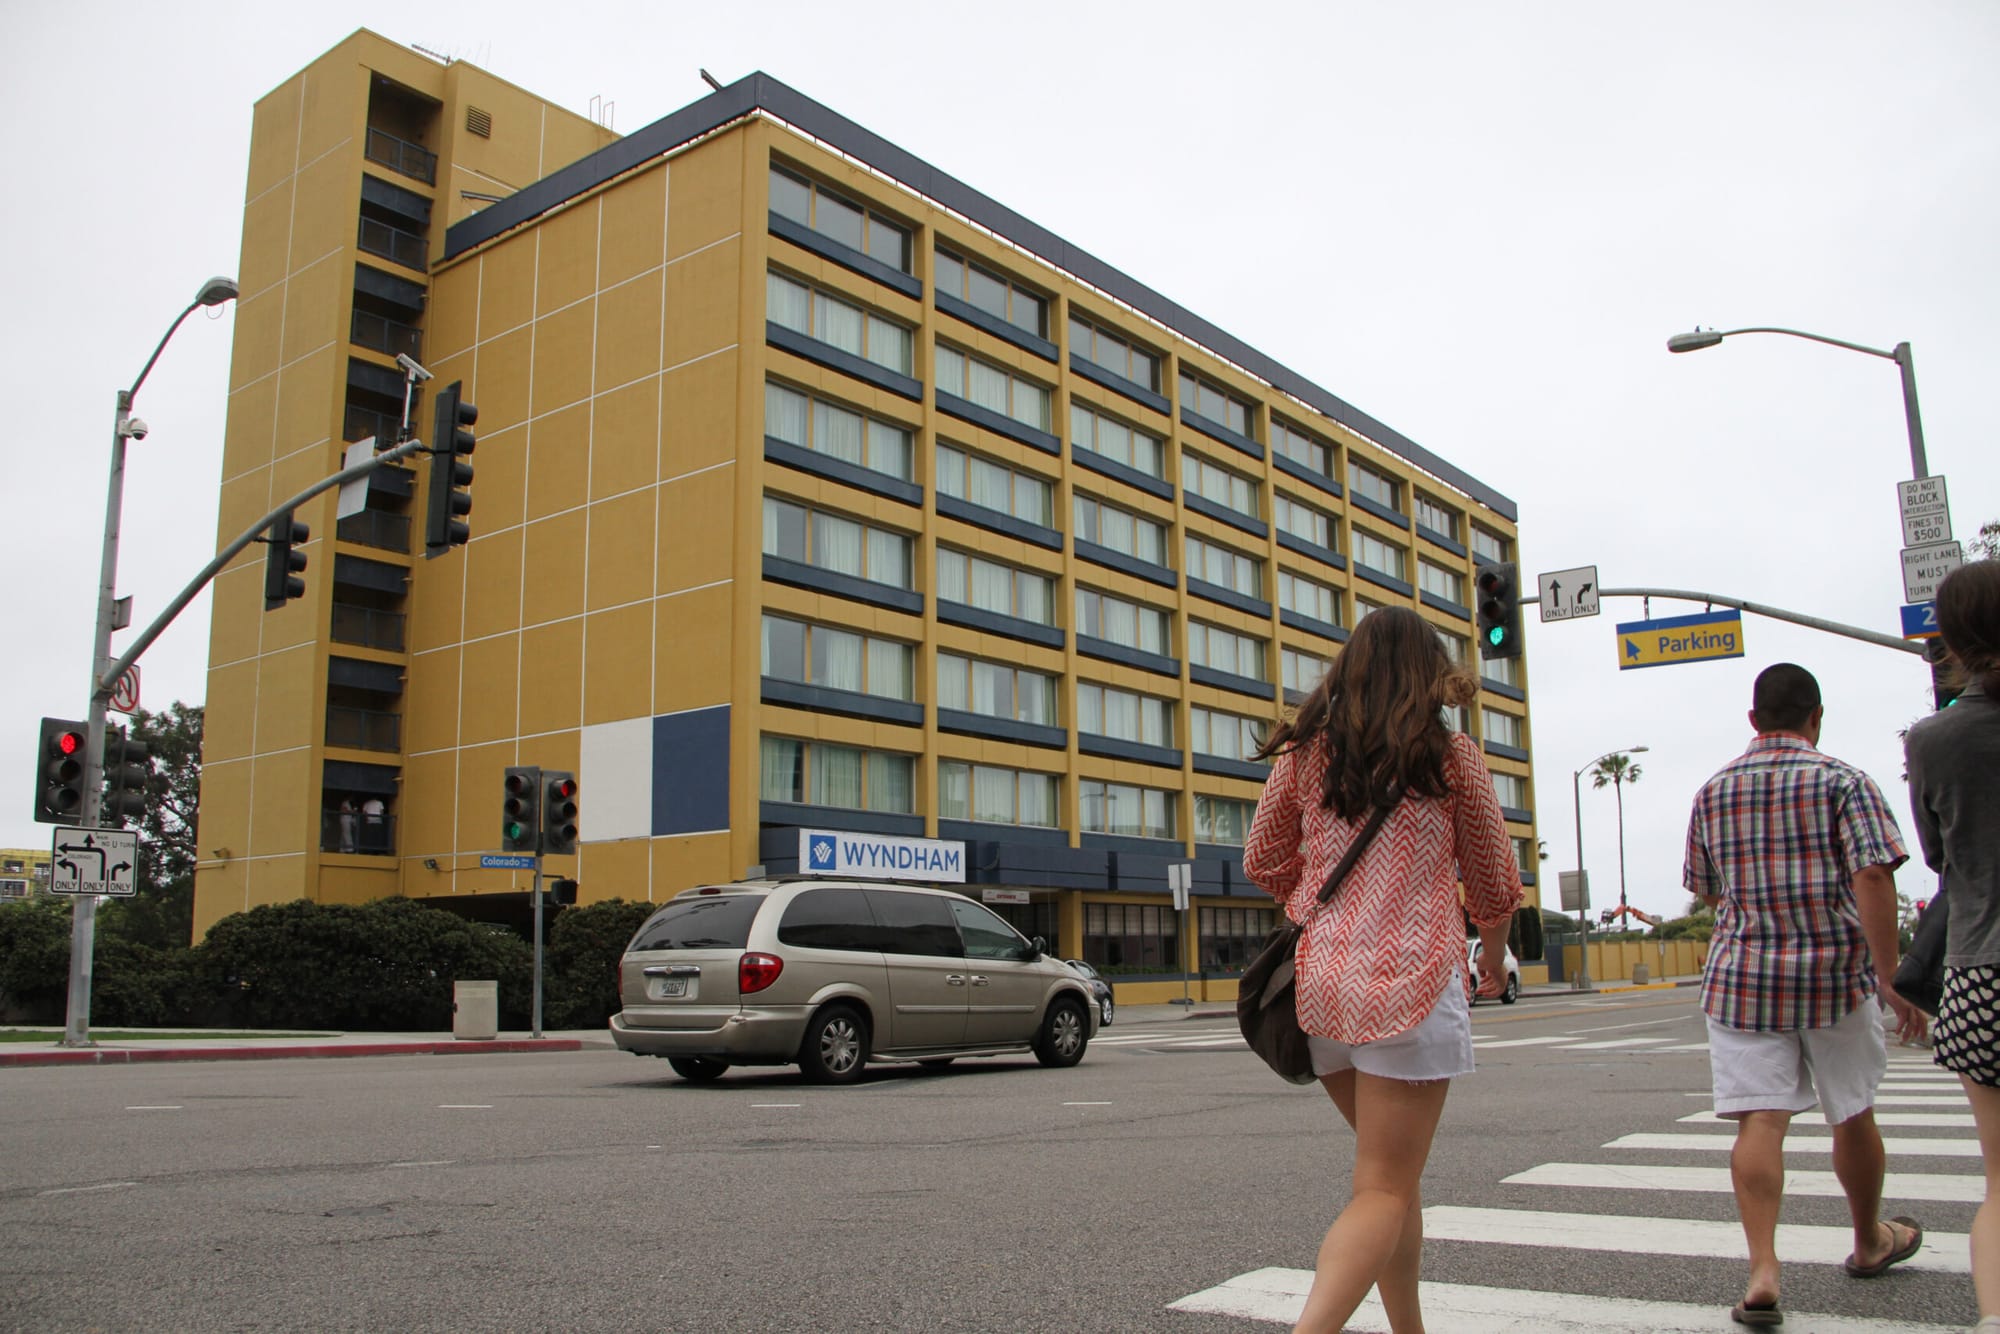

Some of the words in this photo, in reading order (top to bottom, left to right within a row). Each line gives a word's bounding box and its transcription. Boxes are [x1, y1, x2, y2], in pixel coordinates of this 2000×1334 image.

[1906, 484, 1918, 493] DO
[1920, 481, 1936, 491] NOT
[1907, 492, 1939, 506] BLOCK
[1908, 518, 1931, 529] FINES
[1934, 516, 1944, 525] TO
[1914, 527, 1941, 541] $500
[1904, 553, 1930, 565] RIGHT
[1934, 548, 1958, 560] LANE
[1917, 565, 1949, 579] MUST
[1909, 585, 1933, 596] TURN
[1545, 608, 1567, 618] ONLY
[1574, 604, 1597, 615] ONLY
[1658, 631, 1735, 654] Parking
[112, 840, 118, 849] U
[482, 856, 520, 866] Colorado
[843, 841, 960, 873] WYNDHAM
[55, 880, 77, 890] ONLY
[82, 881, 105, 891] ONLY
[110, 882, 132, 892] ONLY
